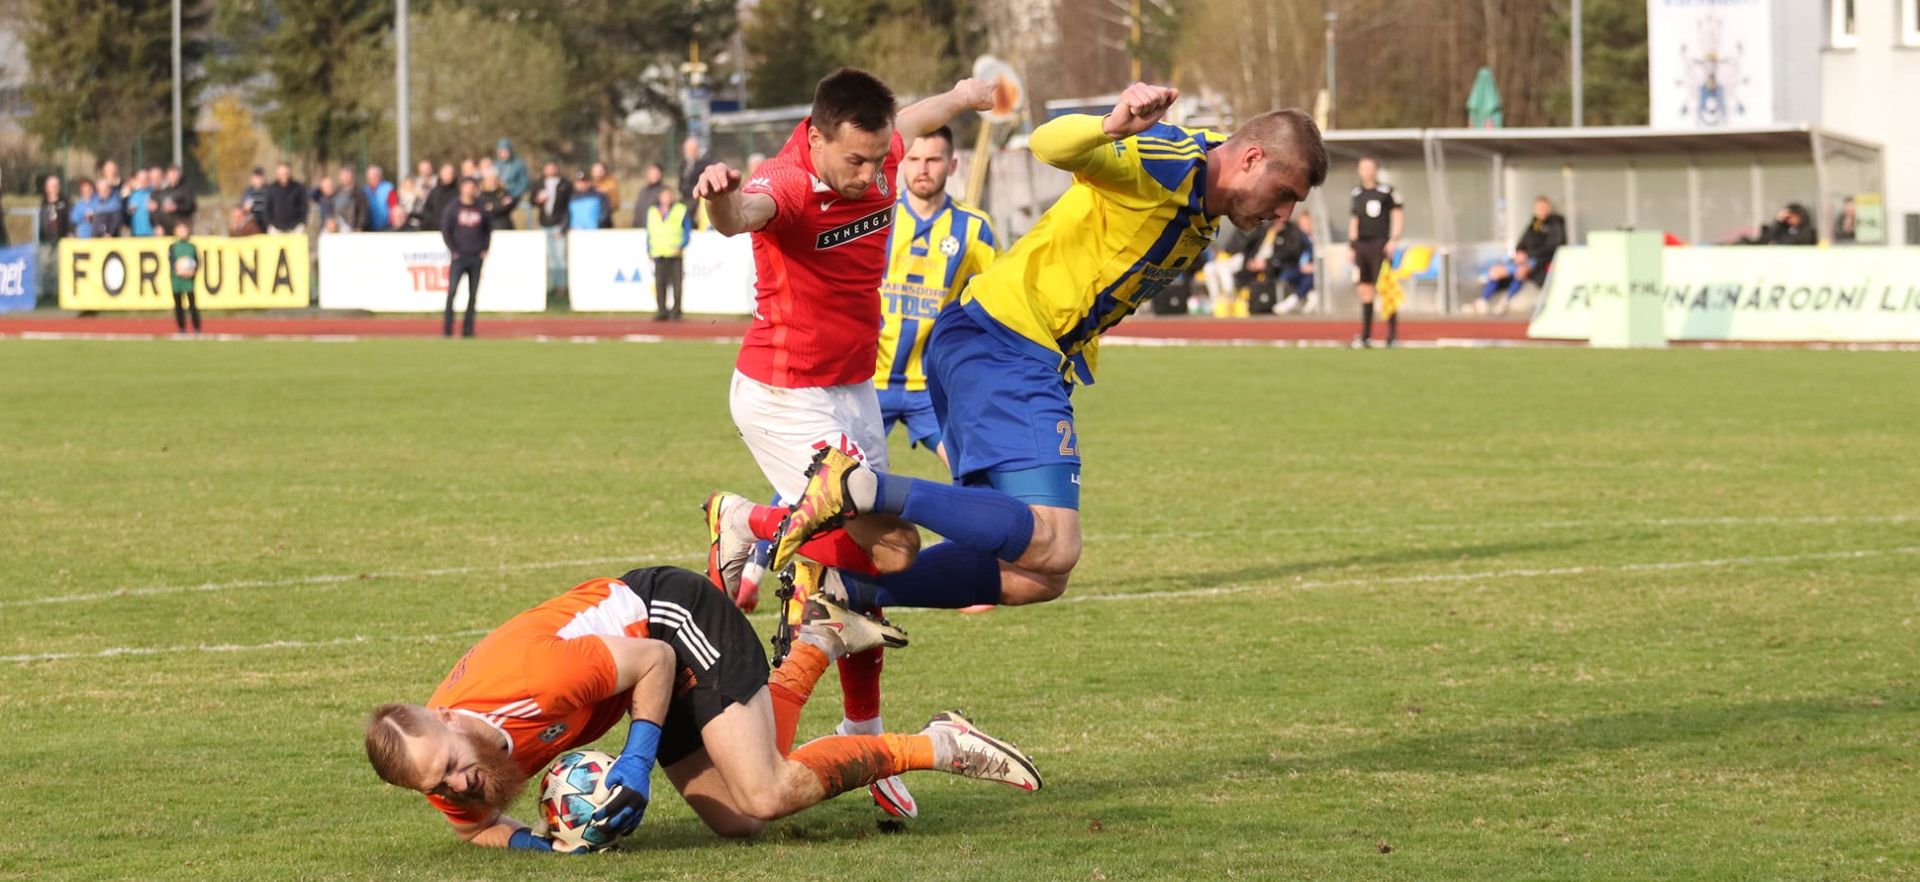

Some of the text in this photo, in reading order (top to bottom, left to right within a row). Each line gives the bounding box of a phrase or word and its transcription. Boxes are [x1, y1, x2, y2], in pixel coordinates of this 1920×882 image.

[823, 213, 888, 245] SYNERGA
[72, 251, 294, 296] FORUNA
[884, 292, 939, 320] TOS
[1057, 420, 1080, 456] 2
